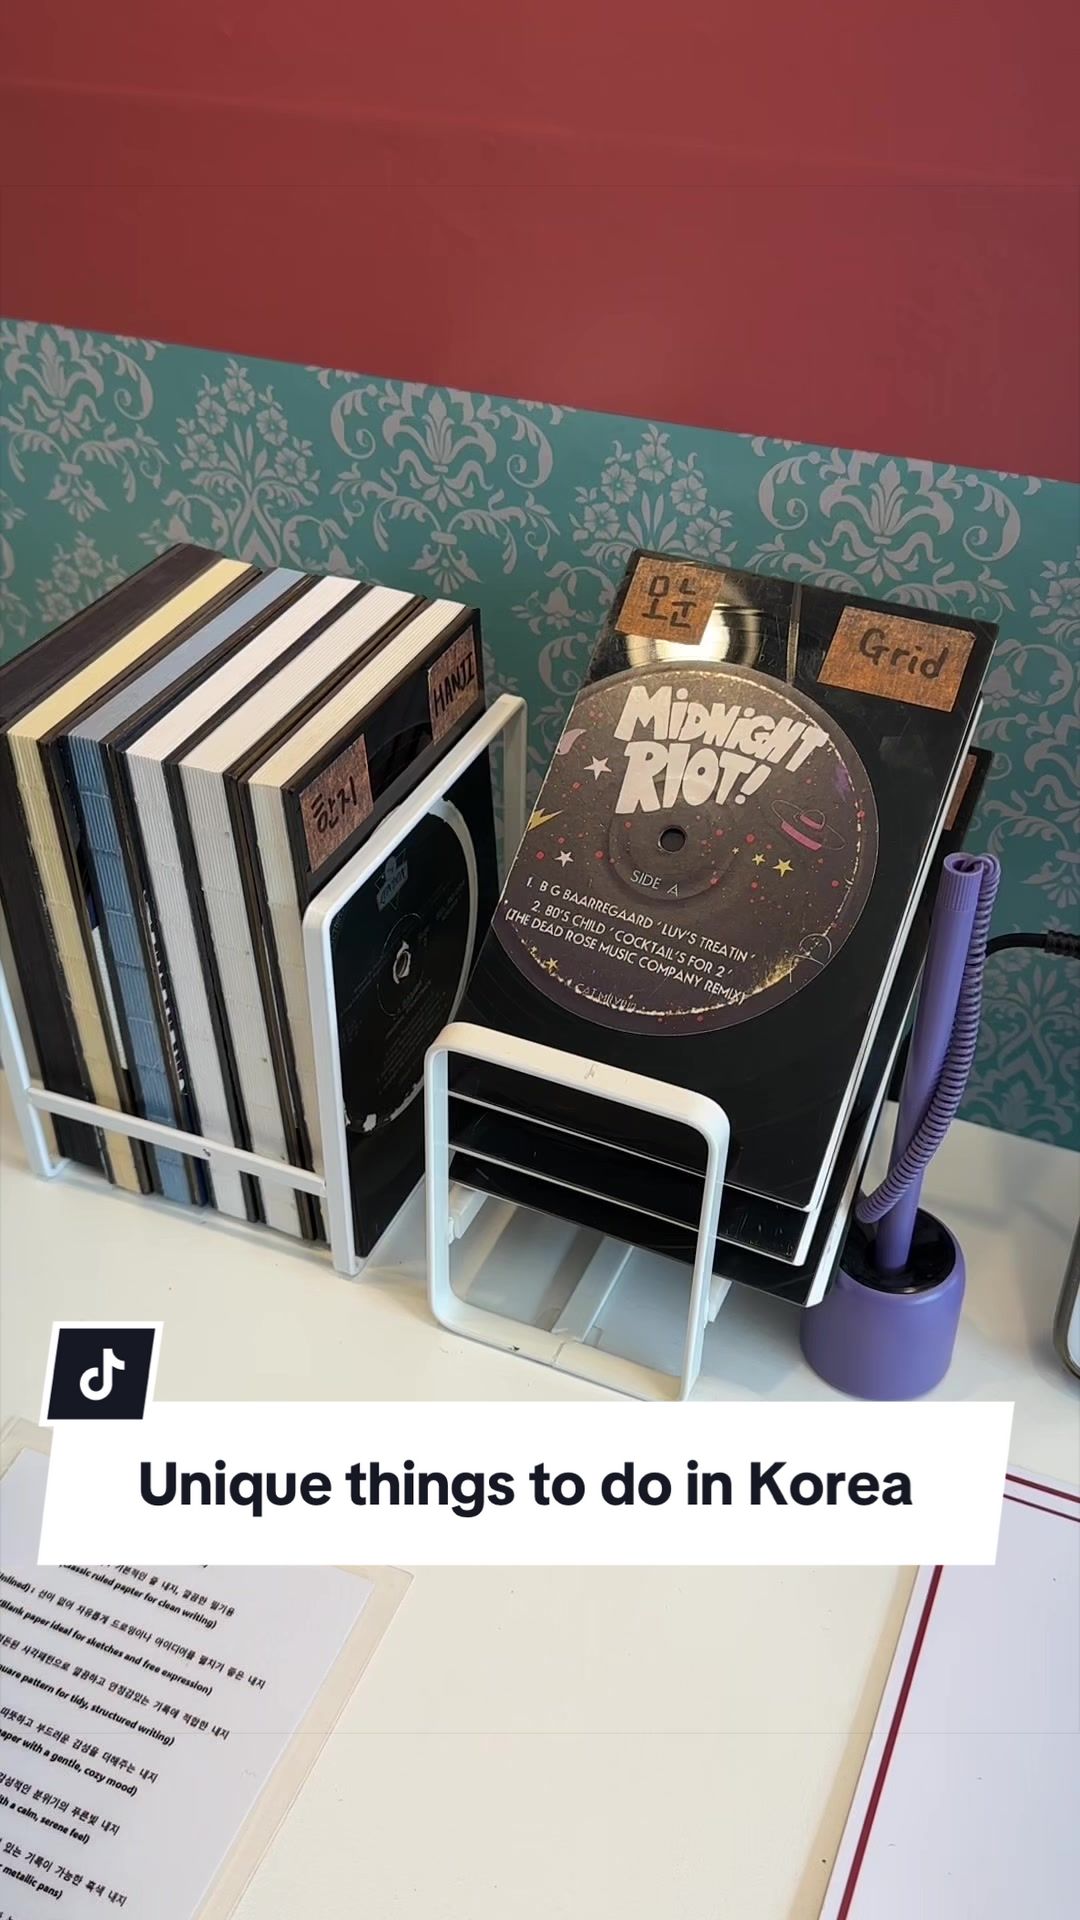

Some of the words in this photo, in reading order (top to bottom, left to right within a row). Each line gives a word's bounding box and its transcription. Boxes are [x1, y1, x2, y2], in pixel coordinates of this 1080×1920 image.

[432, 651, 476, 716] HANJI
[859, 627, 949, 680] Grid
[311, 775, 356, 834] 한지
[615, 741, 772, 814] RIOT!
[540, 881, 548, 891] B
[551, 885, 560, 896] G
[563, 889, 653, 928] BAARREGAARD
[630, 869, 661, 889] SIDE
[667, 885, 677, 896] A
[531, 918, 563, 936] DEAD
[565, 930, 597, 949] ROSE
[598, 942, 637, 964] MUSIC
[639, 957, 703, 986] COMPANY
[704, 980, 746, 1006] REMIX)
[532, 901, 540, 912] 2.
[545, 905, 570, 921] 80'S
[573, 915, 605, 934] CHILD
[688, 956, 712, 972] FOR
[59, 1565, 91, 1578] assic
[91, 1573, 115, 1586] ruled
[144, 1592, 158, 1604] for
[158, 1600, 181, 1614] clean
[182, 1610, 217, 1629] writing)
[161, 1581, 179, 1595] 내지,
[182, 1589, 208, 1606] 깔끔한
[210, 1600, 235, 1616] 필기용
[23, 1612, 50, 1626] paper
[49, 1621, 73, 1636] ideal
[72, 1630, 87, 1641] for
[86, 1637, 124, 1657] sketches
[124, 1654, 143, 1665] and
[142, 1659, 160, 1673] free
[161, 1670, 213, 1696] expression)
[38, 1590, 56, 1602] 선이
[57, 1597, 75, 1610] 없어
[76, 1605, 110, 1624] 자유롭게
[110, 1620, 152, 1642] 드로잉이나
[155, 1637, 196, 1660] 아이디어를
[227, 1667, 244, 1680] 좋은
[248, 1676, 266, 1690] 내지
[20, 1675, 54, 1693] pattern
[55, 1687, 70, 1699] for
[70, 1695, 89, 1710] tidy,
[90, 1705, 138, 1729] structured
[138, 1725, 175, 1747] writing)
[21, 1645, 70, 1671] 사각패턴으로
[72, 1666, 106, 1686] 깔끔하고
[153, 1701, 180, 1719] 기록에
[183, 1713, 209, 1731] 적합한
[211, 1726, 230, 1740] 내지
[0, 1707, 34, 1727] 따뜻하고
[36, 1723, 70, 1744] 부드러운
[72, 1739, 99, 1757] 감성을
[102, 1752, 135, 1774] 더해주는
[139, 1768, 158, 1783] 내지
[0, 1728, 22, 1743] aper
[22, 1740, 43, 1754] with
[50, 1753, 82, 1773] gentle,
[84, 1768, 106, 1783] cozy
[106, 1778, 137, 1797] mood)
[17, 1806, 38, 1822] calm,
[40, 1817, 69, 1834] serene
[69, 1828, 90, 1844] feel)
[32, 1789, 70, 1813] 분위기의
[71, 1806, 99, 1826] 푸른빛
[101, 1820, 120, 1835] 내지
[2, 1867, 38, 1887] metallic
[3, 1842, 21, 1858] 있는
[25, 1852, 53, 1872] 기록이
[54, 1866, 83, 1886] 가능한
[108, 1890, 127, 1907] 내지
